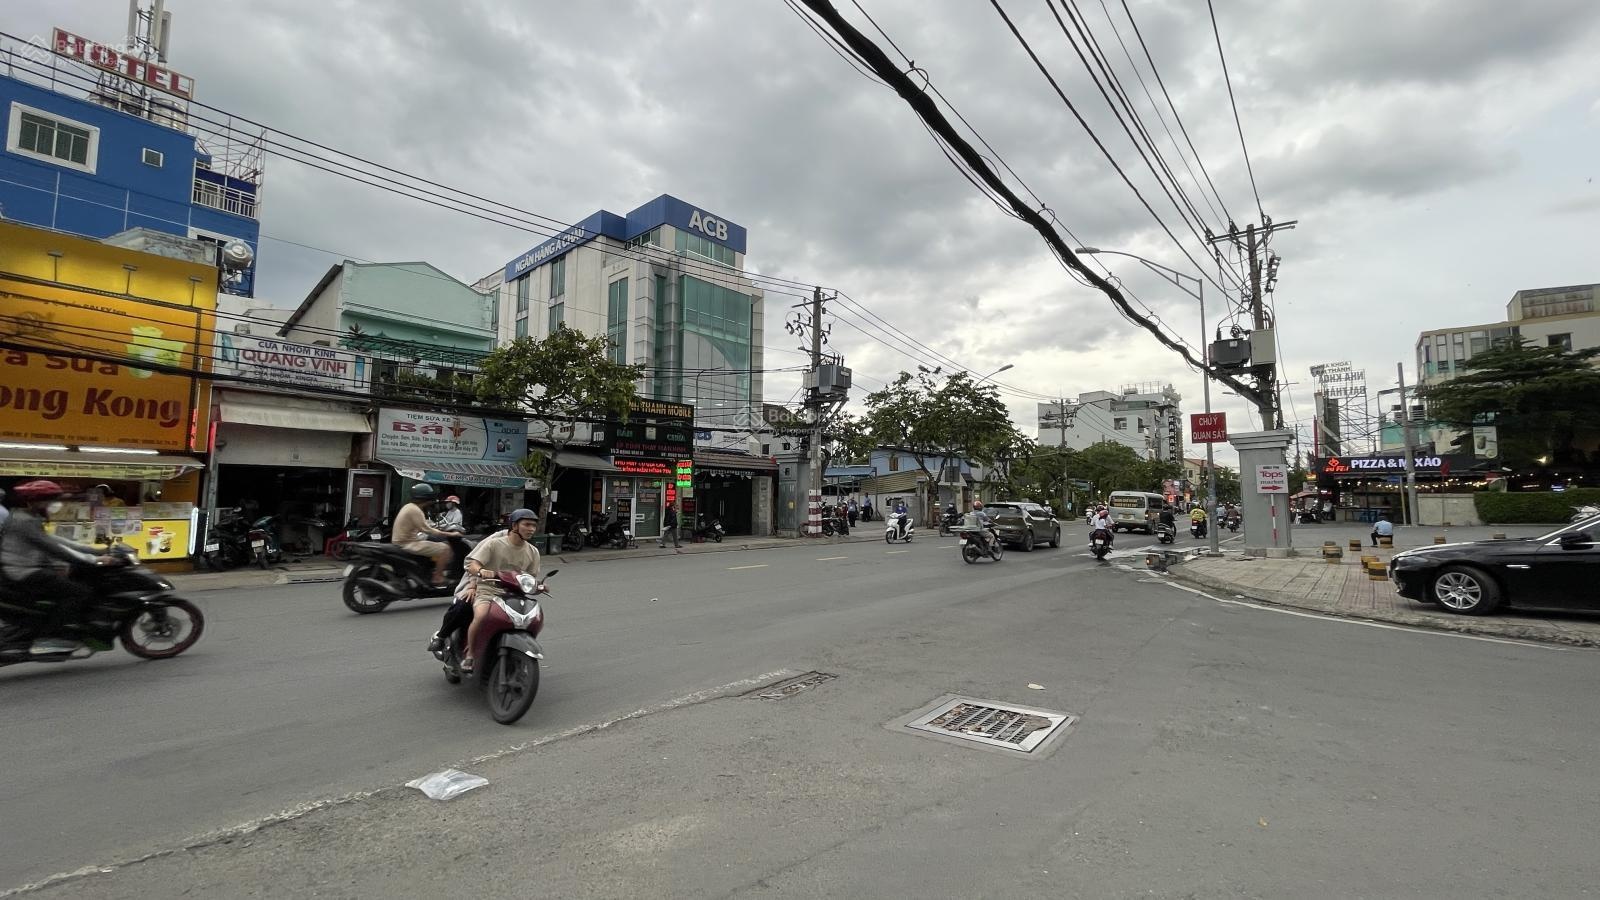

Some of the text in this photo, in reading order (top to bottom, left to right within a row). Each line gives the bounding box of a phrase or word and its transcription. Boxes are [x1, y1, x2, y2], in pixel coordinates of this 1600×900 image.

[57, 30, 190, 97] HOTEL
[688, 210, 728, 241] ACB
[515, 253, 534, 273] NGÂN
[535, 242, 556, 263] HÀNG
[562, 225, 585, 248] CHÂU
[242, 350, 307, 368] QUANG
[311, 357, 348, 374] VINH
[0, 385, 182, 428] ong Kong
[668, 406, 692, 417] MOBILE
[1198, 414, 1218, 426] CHÚ Ý
[1193, 429, 1226, 440] QUAN SÁT
[1351, 459, 1386, 469] PIZZA
[1387, 459, 1397, 468] &
[1414, 456, 1441, 467] XÀO
[1260, 471, 1283, 480] Tops
